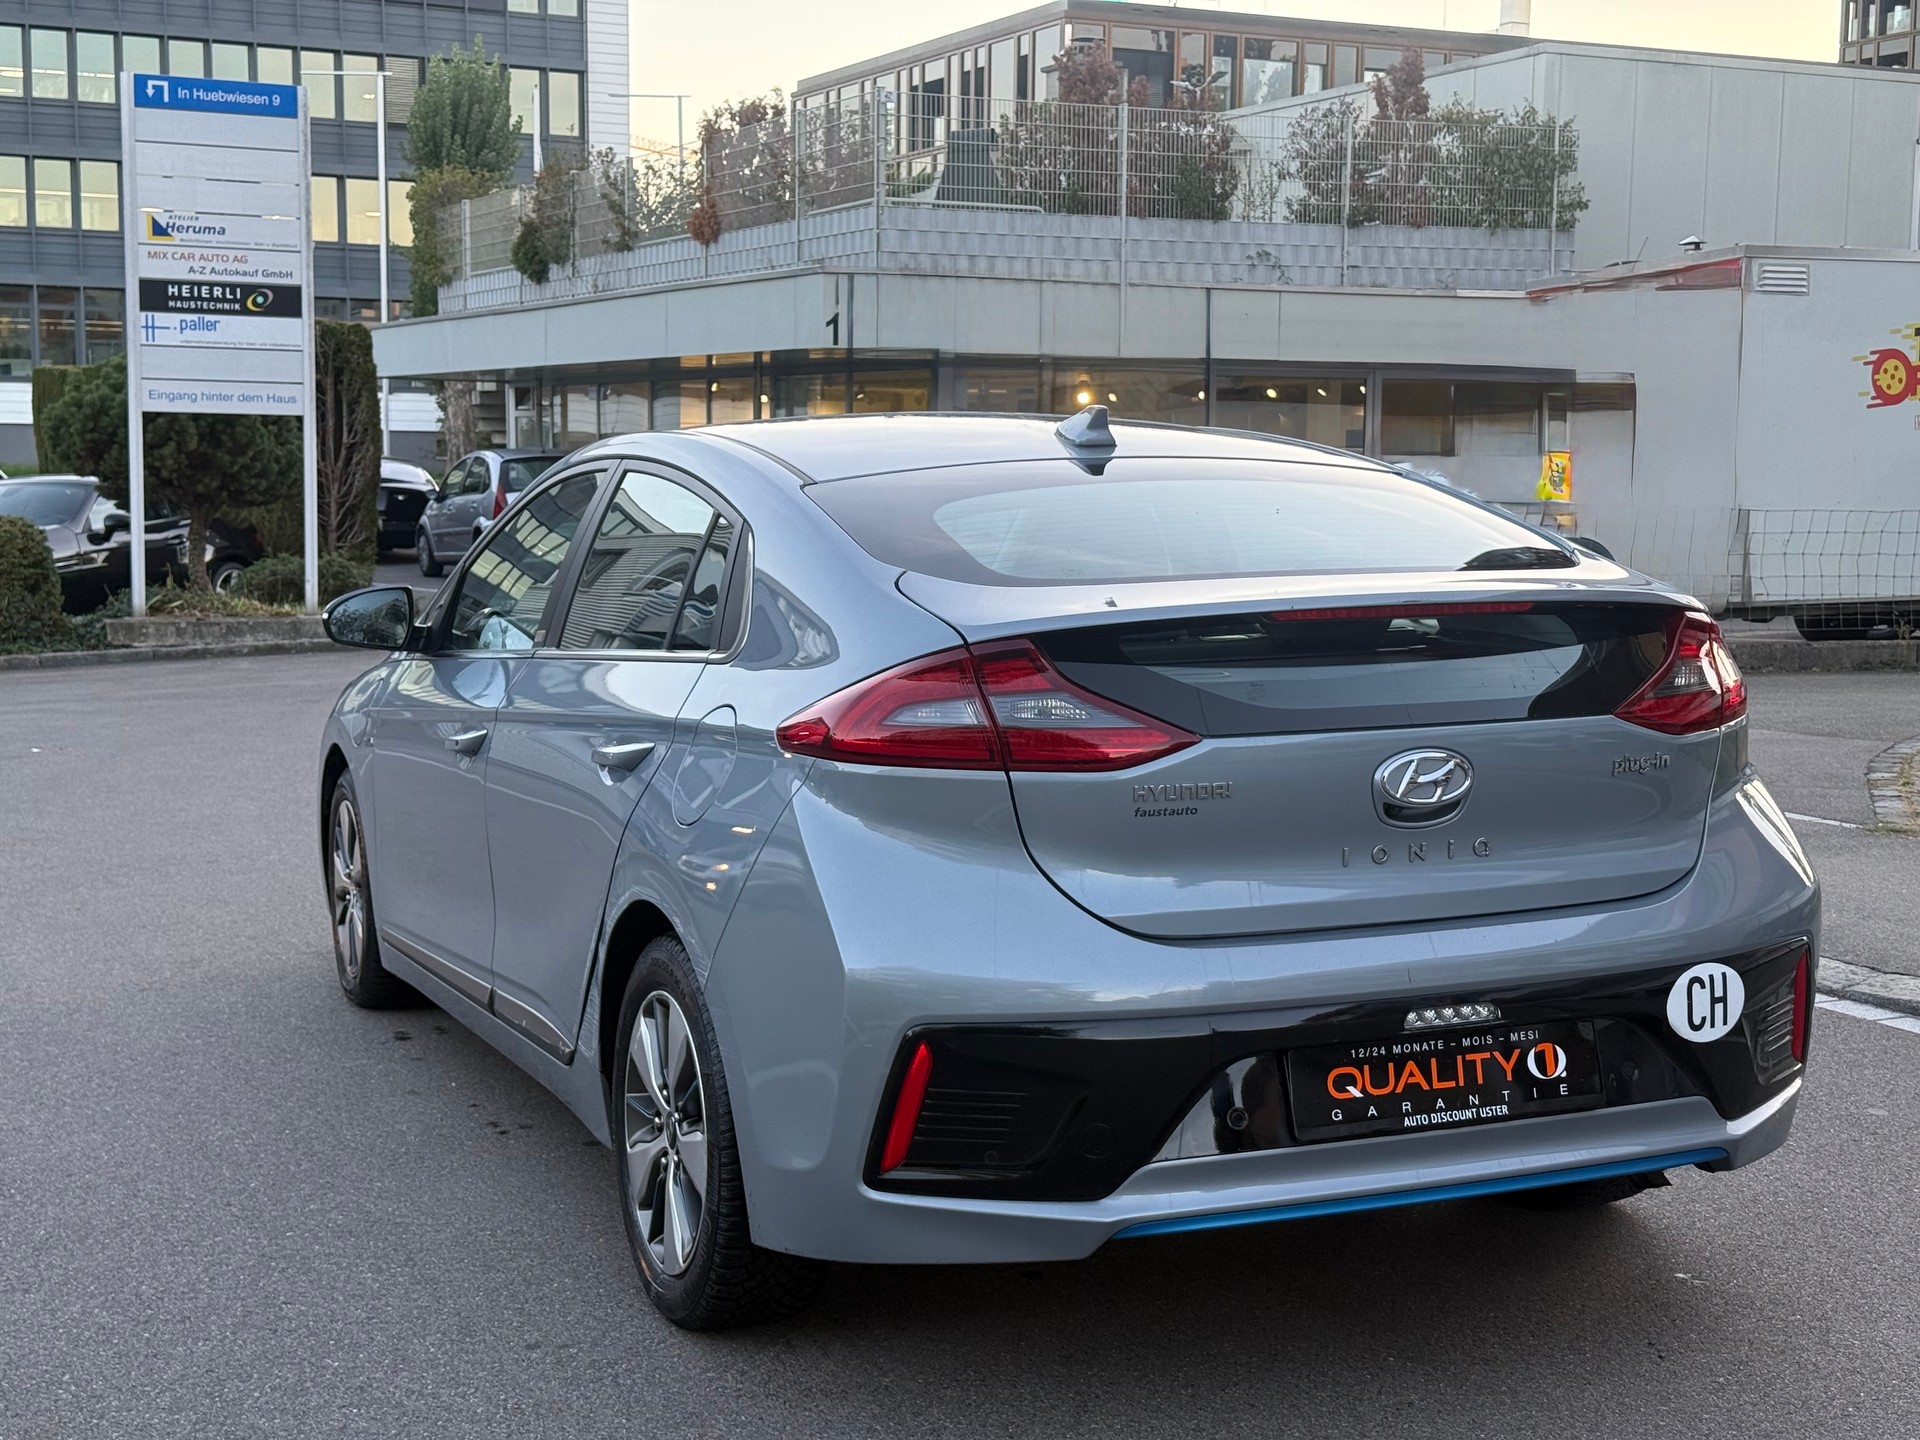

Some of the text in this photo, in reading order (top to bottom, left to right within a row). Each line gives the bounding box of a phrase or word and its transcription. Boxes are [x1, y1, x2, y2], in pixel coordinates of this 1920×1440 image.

[177, 86, 281, 106] In Huebwiesen 9
[168, 214, 200, 222] ATELIER
[165, 221, 227, 236] Heruma
[147, 251, 248, 264] MIX CAR AUTO AG
[188, 266, 293, 280] A-Z Autokauf GmbH
[167, 284, 241, 300] HEIERLI
[168, 300, 241, 311] HAUSTECHNIK
[825, 312, 839, 346] 1
[148, 389, 298, 405] Eingang hinter dem Haus
[1612, 751, 1671, 777] plug-in
[1132, 781, 1233, 802] HYUNDAI
[1134, 805, 1198, 818] faustauto
[1342, 836, 1490, 868] IONIQ
[1686, 971, 1729, 1032] CH
[1350, 1045, 1386, 1059] 12/24
[1392, 1039, 1445, 1055] MONATE
[1462, 1034, 1493, 1047] MOIS
[1510, 1030, 1540, 1042] MESI
[1326, 1048, 1522, 1100] QUALITY
[1331, 1083, 1569, 1121] GARANTIE
[1403, 1104, 1509, 1127] AUTO DISCOUNT USTER
